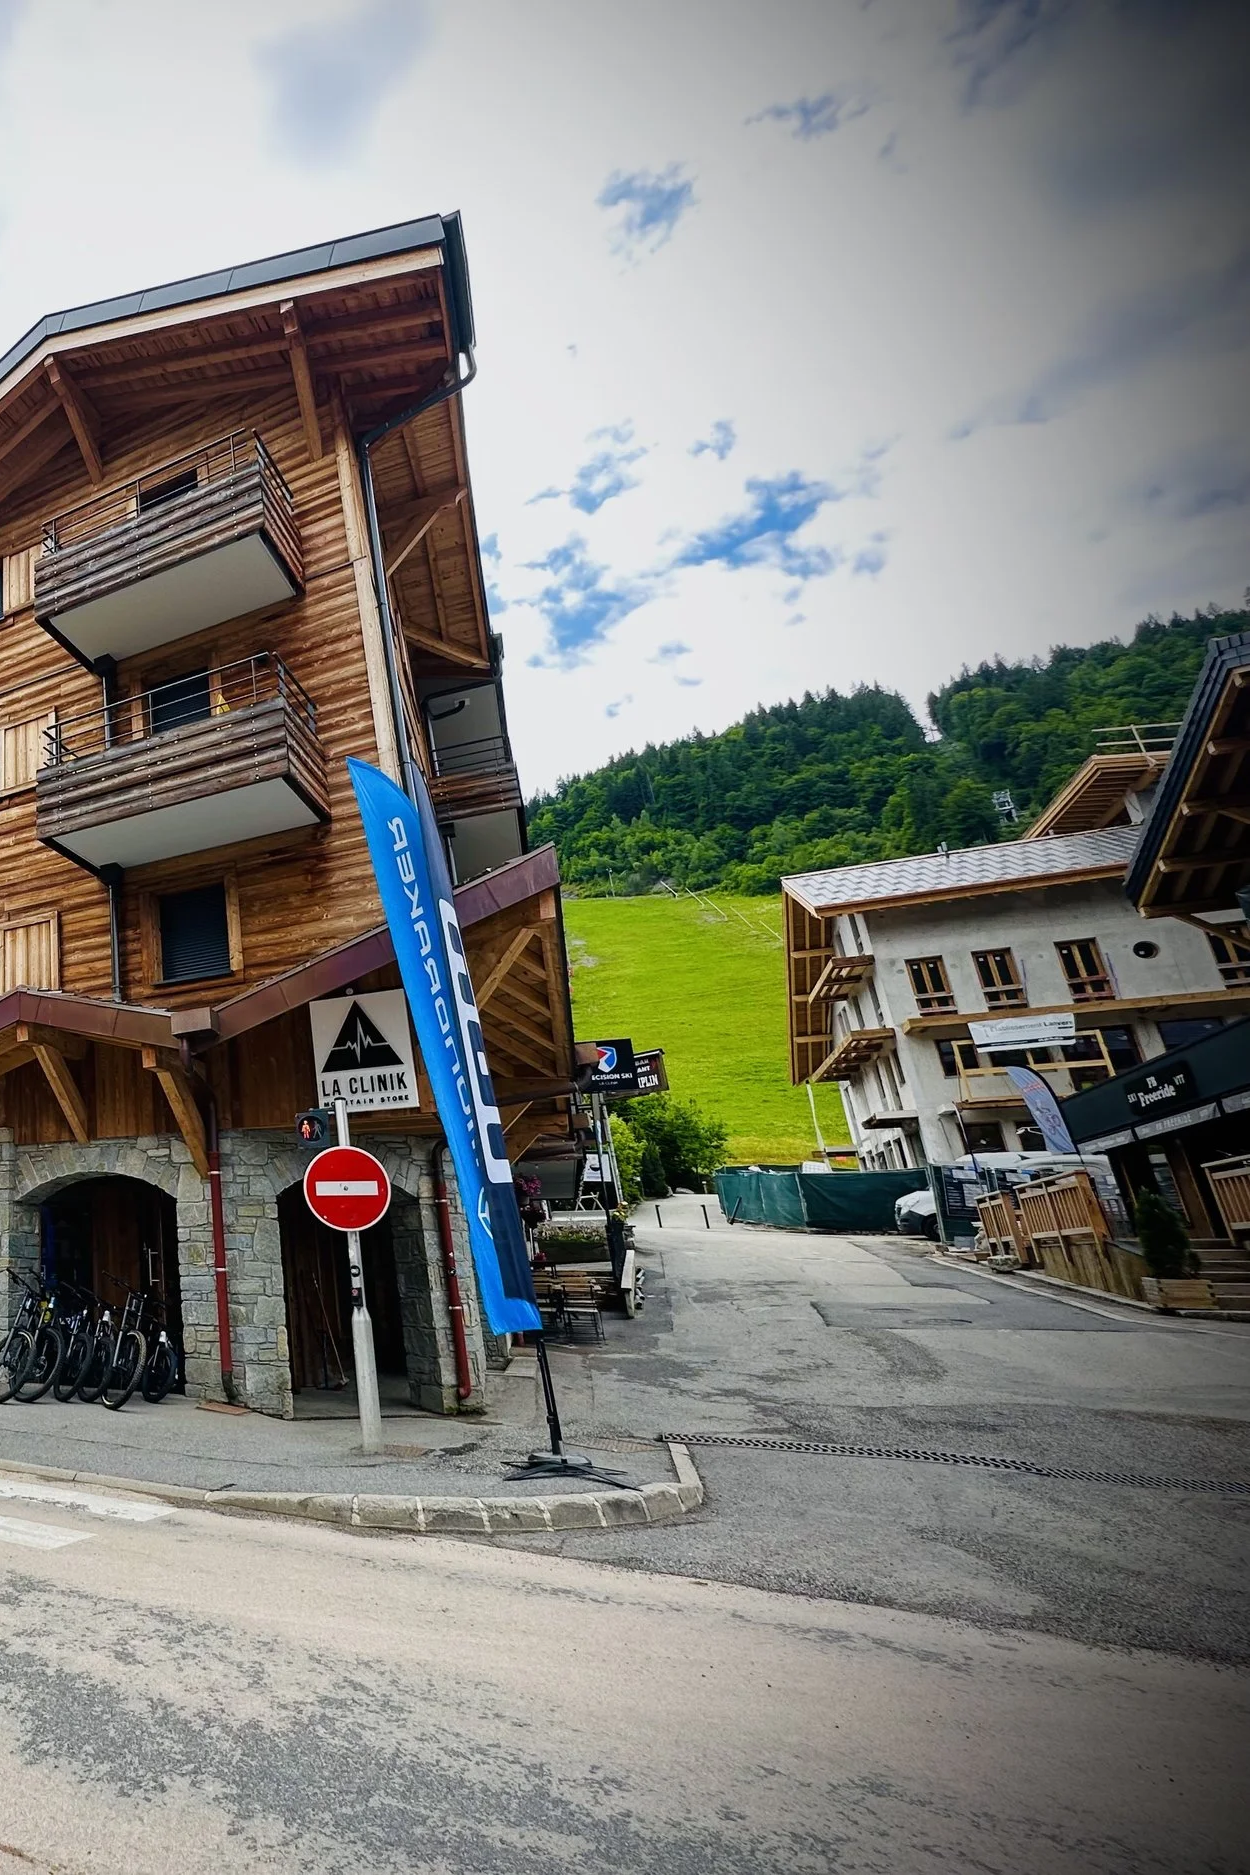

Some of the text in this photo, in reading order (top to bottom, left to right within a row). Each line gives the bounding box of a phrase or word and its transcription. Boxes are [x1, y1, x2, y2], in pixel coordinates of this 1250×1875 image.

[591, 1073, 620, 1081] ECISION
[637, 1074, 659, 1088] PLIN
[321, 1072, 407, 1097] LA CLINIK
[324, 1094, 410, 1107] MOTAIN STORE
[1138, 1083, 1176, 1107] Freeride
